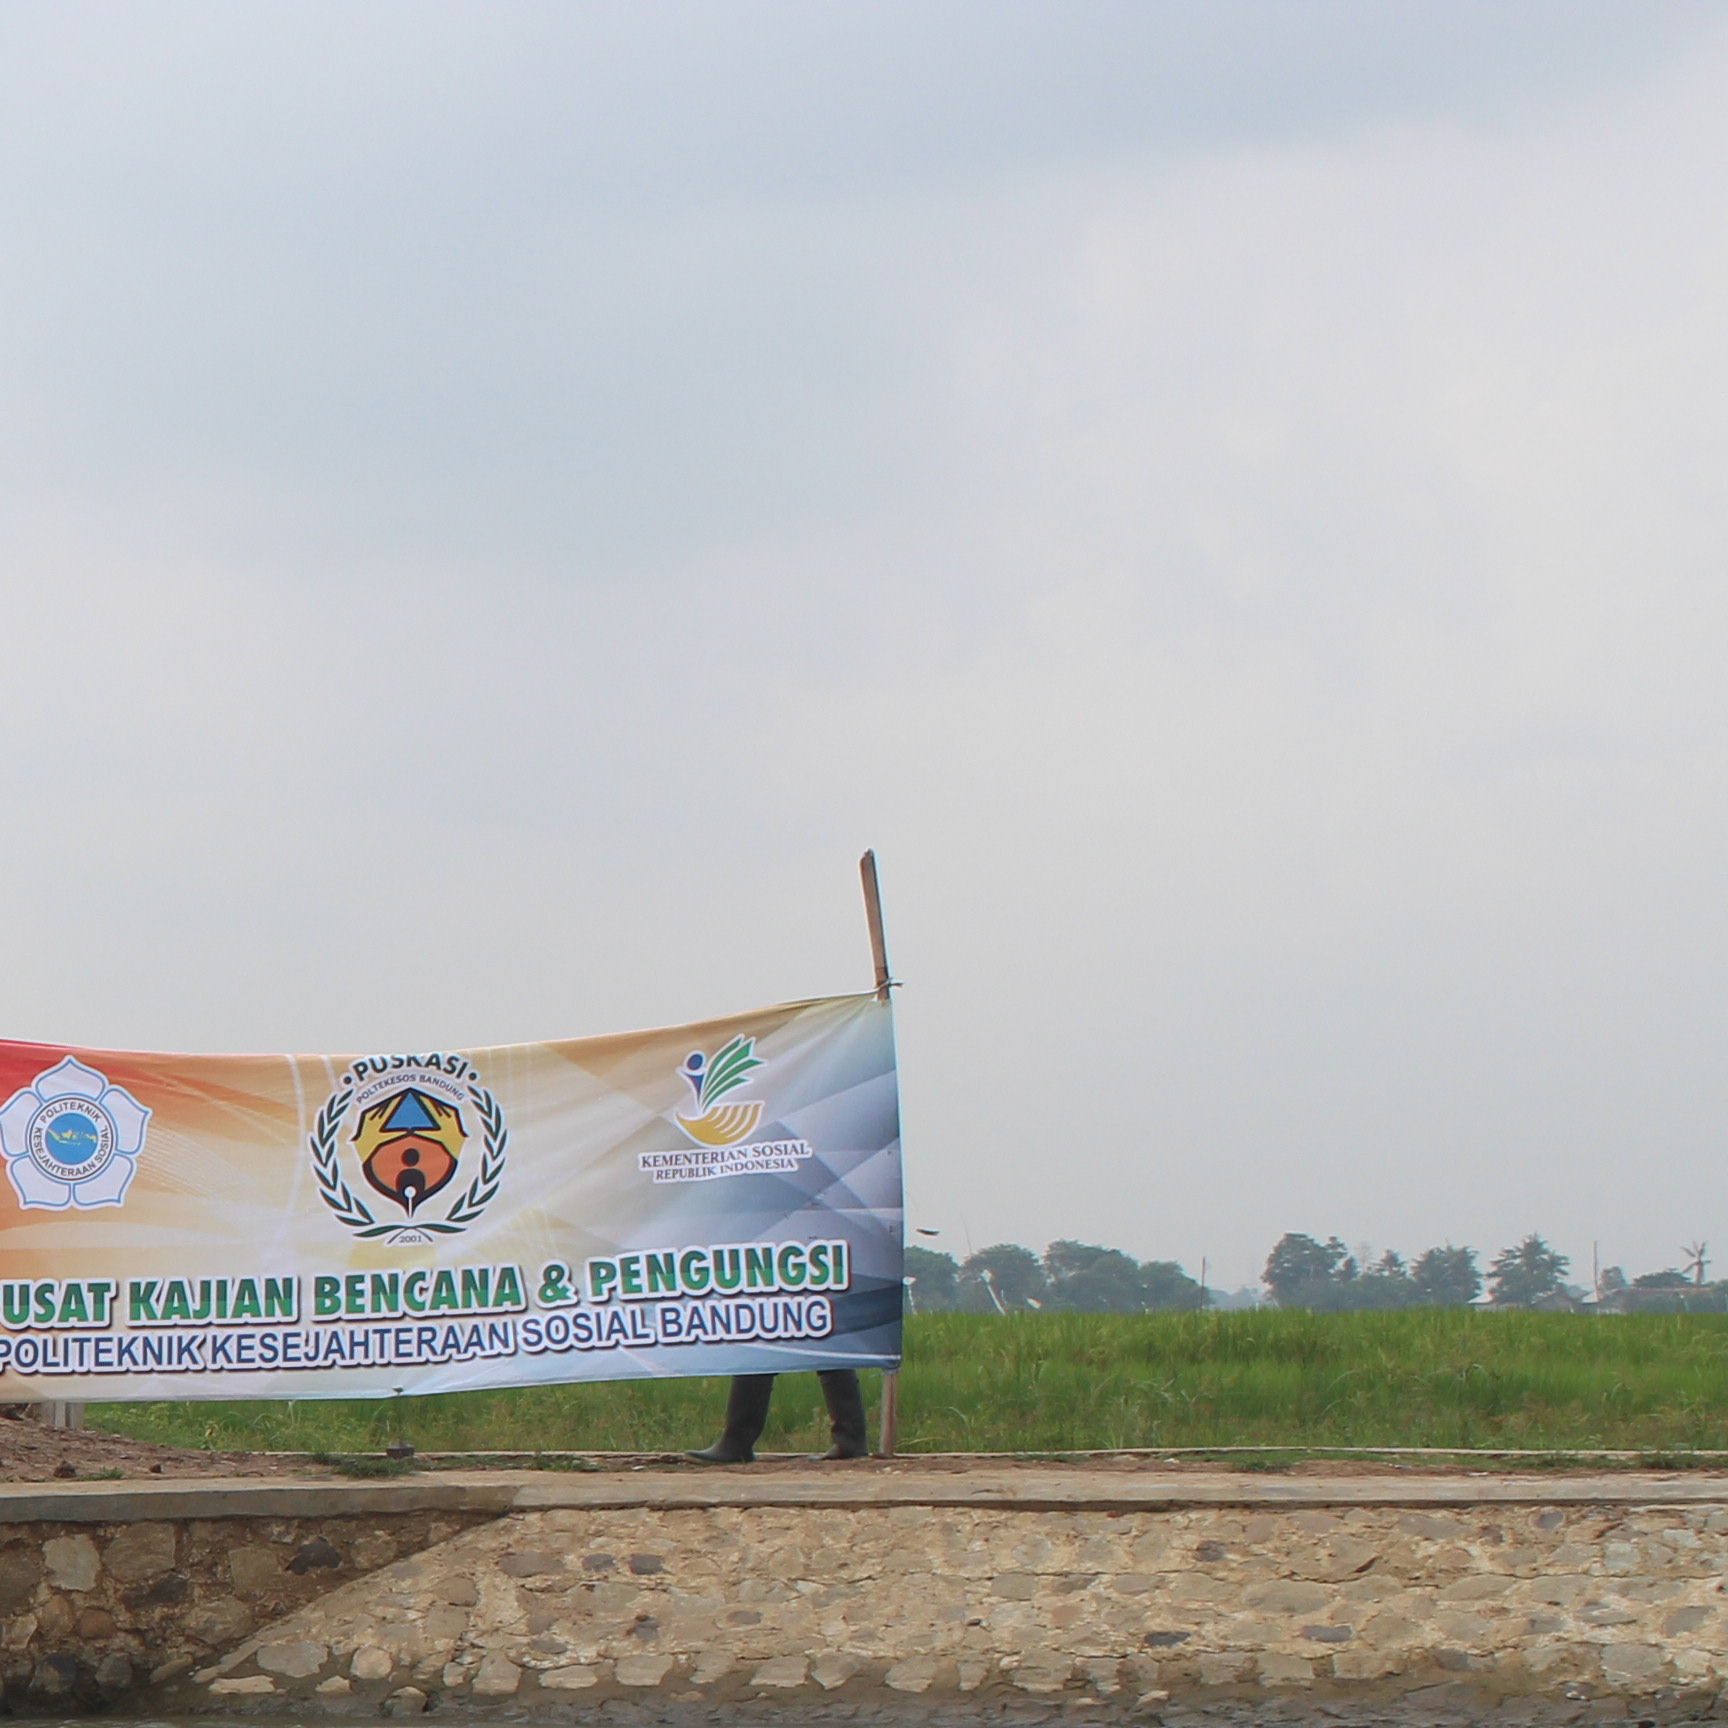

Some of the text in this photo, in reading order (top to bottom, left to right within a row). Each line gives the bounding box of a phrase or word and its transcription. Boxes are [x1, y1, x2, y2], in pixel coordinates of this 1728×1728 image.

[352, 1052, 469, 1083] PUSKASI
[356, 1073, 465, 1105] POLTEKESOS BANDUNG
[40, 1102, 102, 1124] POLITEKNIK
[33, 1125, 110, 1177] KESEJAHTERAAN SOSIAL
[641, 1142, 810, 1169] KEMENTERIAN SOSIAL
[655, 1159, 795, 1181] REPUBLIK INDONESIA
[398, 1235, 422, 1244] 2001
[129, 1275, 295, 1323] KAJIAN
[313, 1265, 523, 1317] BENCANA
[538, 1263, 573, 1303] &
[588, 1243, 847, 1299] PENGUNGSI
[211, 1322, 515, 1365] KESEJAHTERAAN
[522, 1307, 649, 1348] SOSIAL
[661, 1300, 829, 1340] BANDUNG
